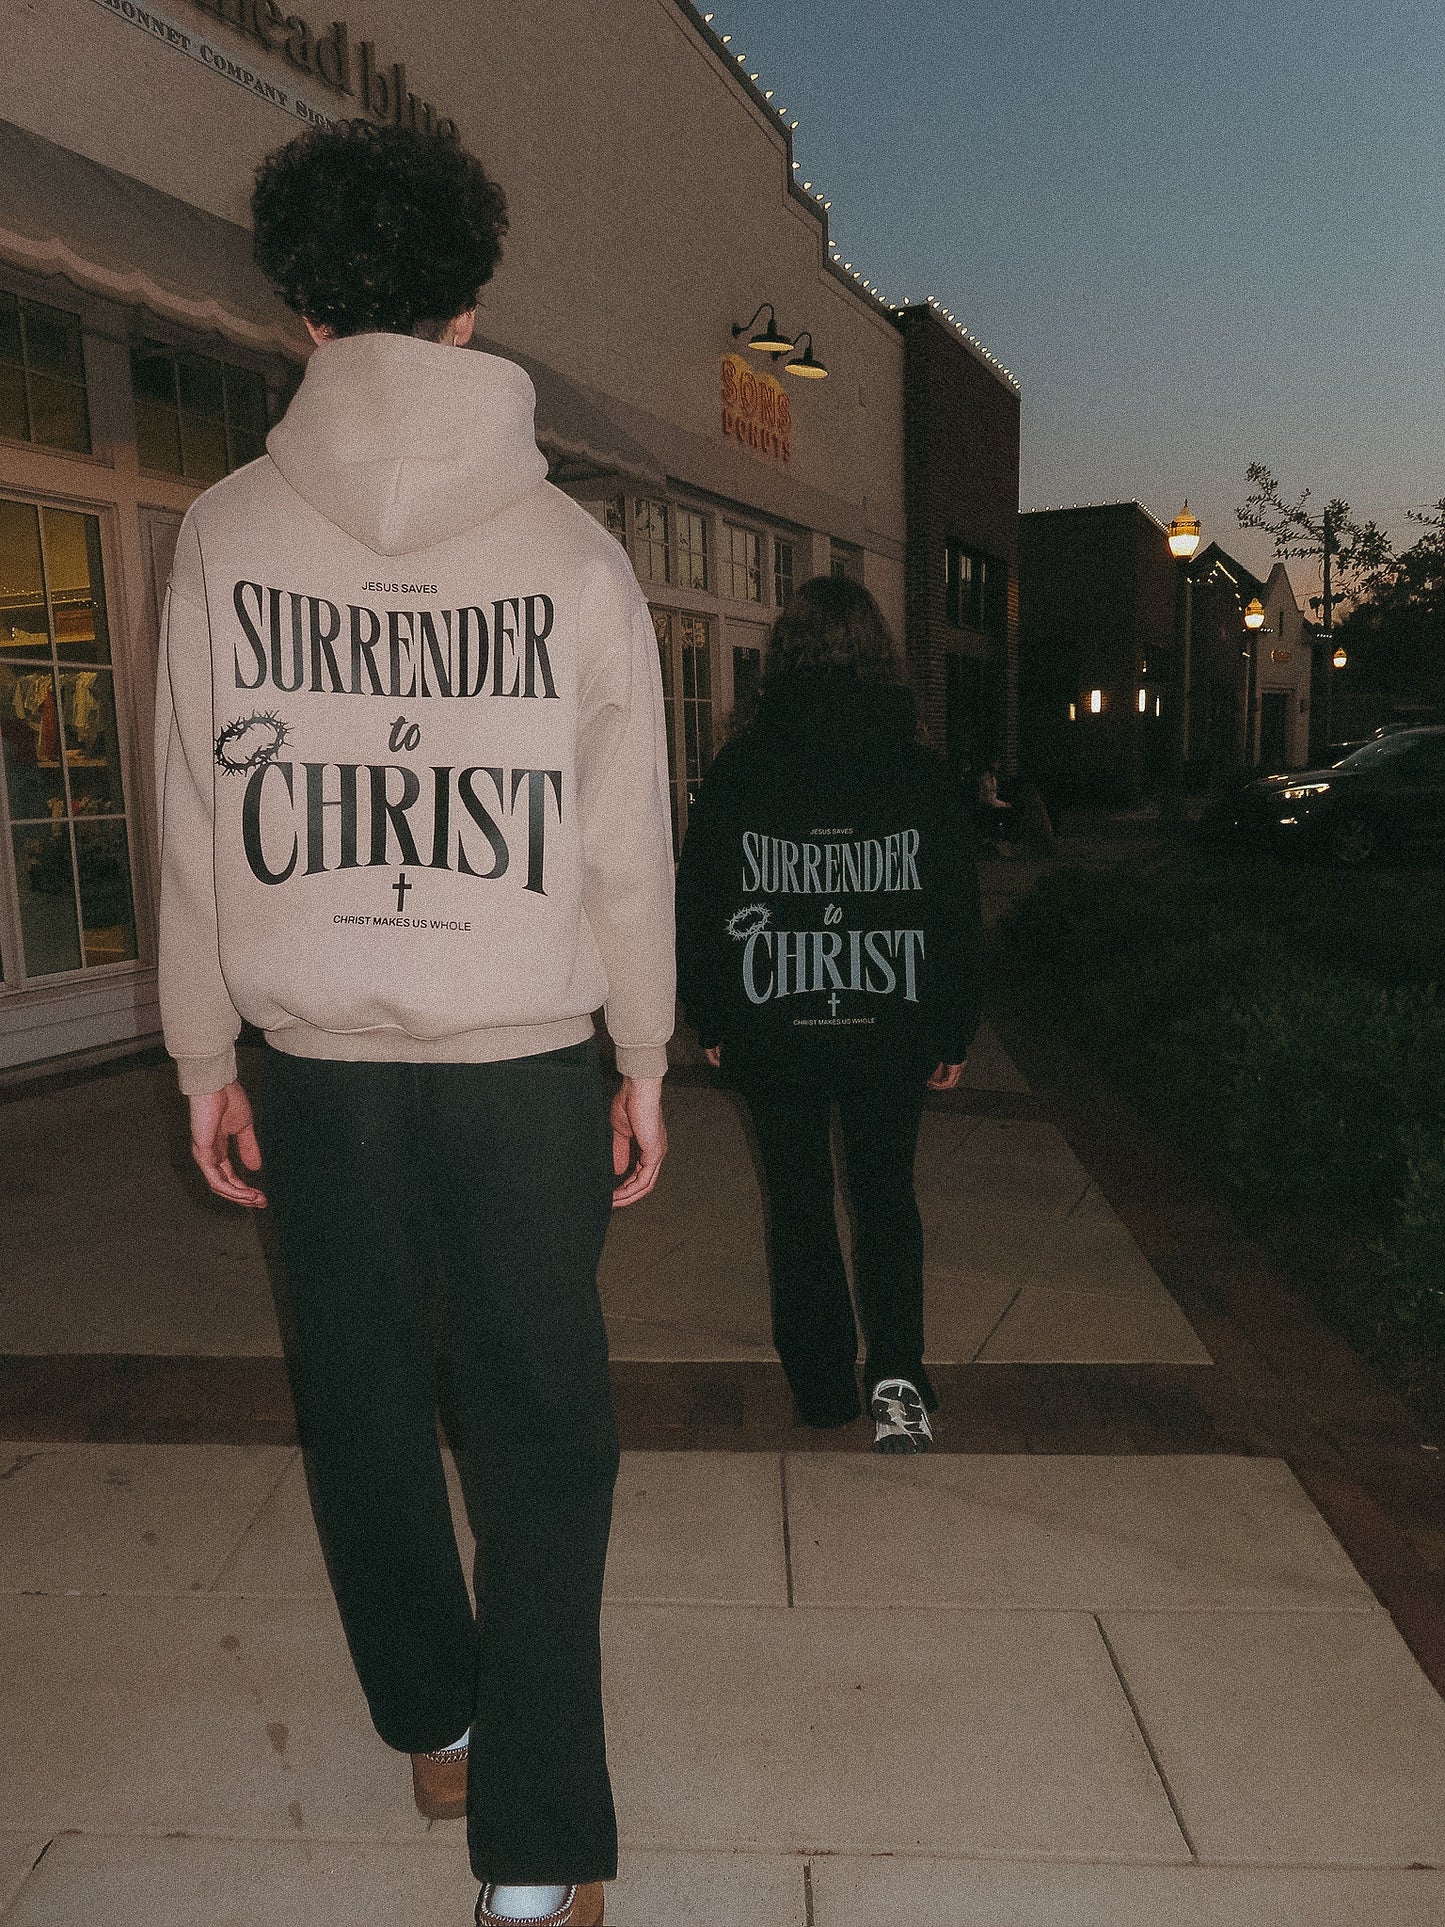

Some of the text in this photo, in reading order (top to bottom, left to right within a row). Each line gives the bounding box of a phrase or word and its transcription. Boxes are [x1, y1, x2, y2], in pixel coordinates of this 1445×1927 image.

[200, 44, 288, 107] COMPANY
[722, 360, 791, 434] SONS
[361, 581, 438, 594] JESUS SAVES
[232, 580, 560, 699] SURRENDER
[387, 715, 421, 753] to
[242, 761, 562, 896] CHRIST
[742, 829, 923, 893] SURRENDER
[333, 914, 471, 931] CHRIST MAKES US WHOLE
[823, 903, 843, 926] to
[743, 930, 925, 1004] CHRIST
